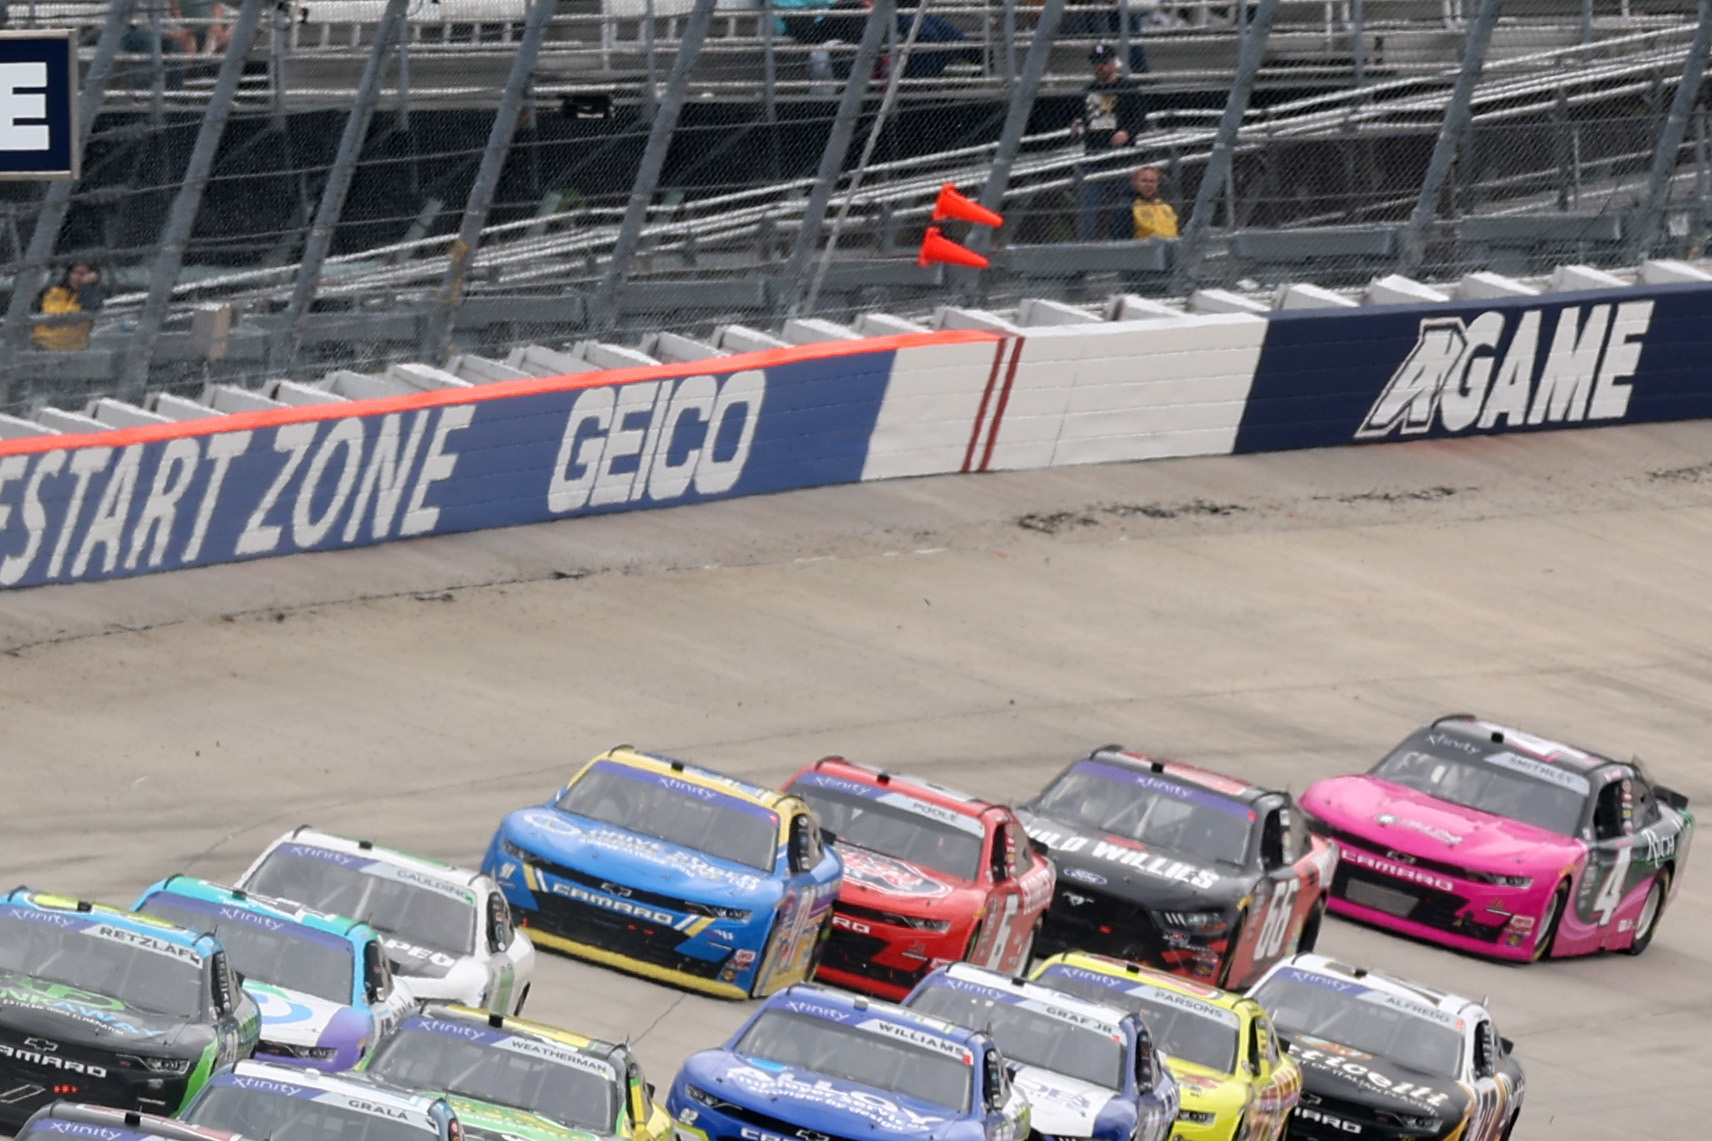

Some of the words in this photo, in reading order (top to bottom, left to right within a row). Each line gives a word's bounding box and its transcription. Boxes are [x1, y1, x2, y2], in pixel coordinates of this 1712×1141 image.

[235, 403, 476, 555] ZONE
[547, 369, 767, 515] GEICO
[912, 802, 959, 823] POOLE
[1024, 825, 1089, 852] WILD
[1092, 840, 1219, 889] WILLIES
[1593, 846, 1632, 927] 4
[553, 882, 673, 923] CAMARO
[219, 907, 286, 930] xfinity
[100, 926, 196, 962] RETZLAF
[1154, 990, 1223, 1020] PARSONS
[1385, 996, 1451, 1024] ALFREDO
[785, 1000, 851, 1022] xfinity
[878, 1020, 967, 1057] WILLIAMS
[1045, 1005, 1092, 1027] GRAF
[1093, 1020, 1115, 1036] JR
[418, 1019, 486, 1041] xfinity
[510, 1038, 608, 1074] WEATHERMAN
[231, 1075, 302, 1096] xfinity
[48, 1119, 123, 1141] xfinity
[678, 1107, 699, 1126] 92
[1294, 1107, 1362, 1135] ARO
